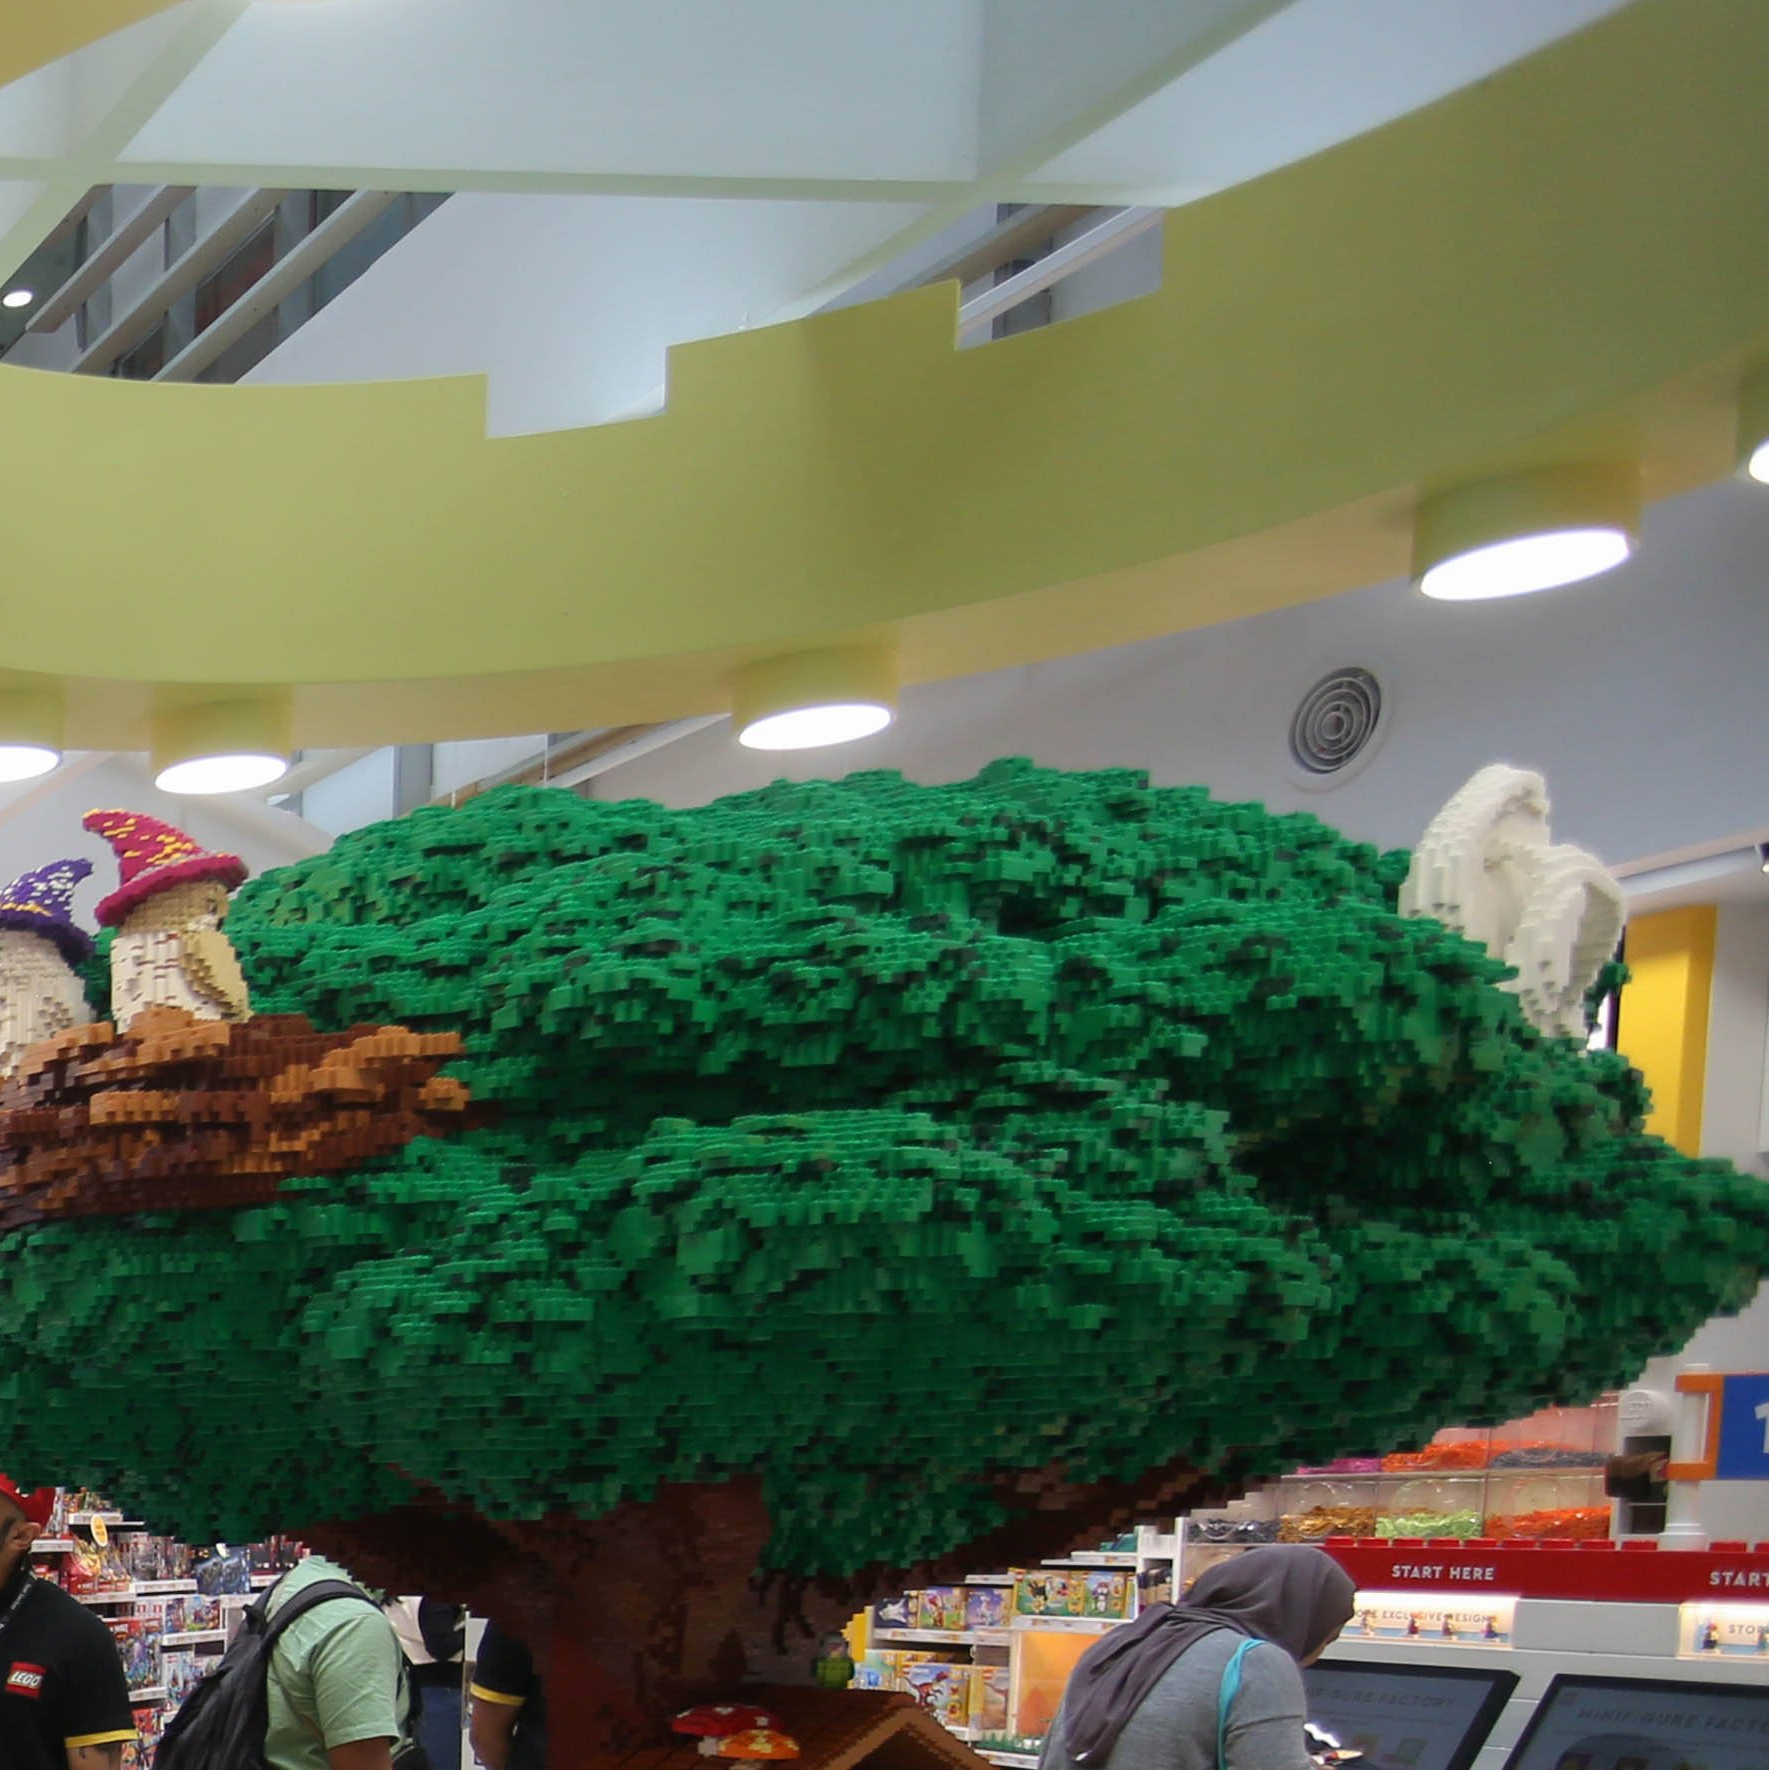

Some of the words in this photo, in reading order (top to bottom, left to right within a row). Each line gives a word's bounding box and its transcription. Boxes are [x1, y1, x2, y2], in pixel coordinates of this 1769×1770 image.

[1391, 1564, 1443, 1580] START
[1449, 1566, 1495, 1581] HERE
[10, 1671, 42, 1688] LEGO
